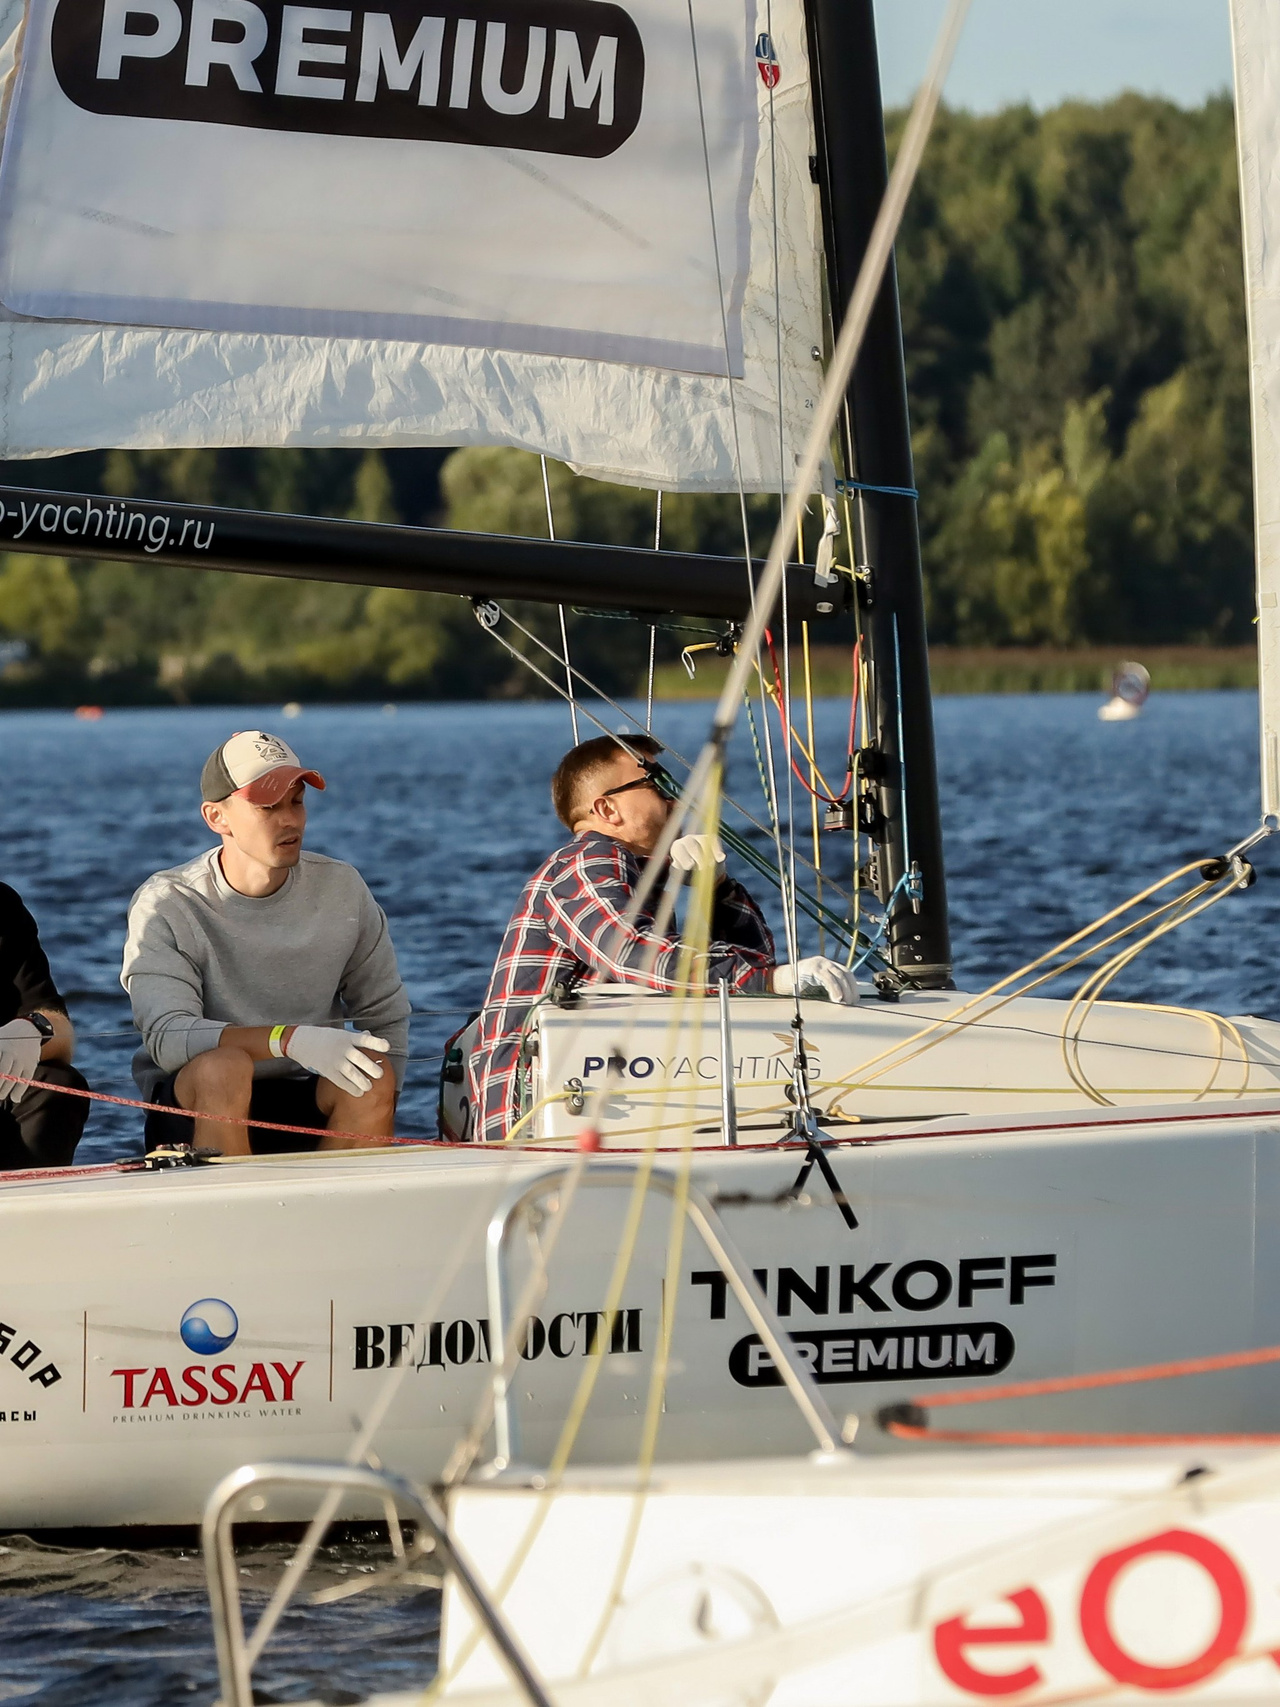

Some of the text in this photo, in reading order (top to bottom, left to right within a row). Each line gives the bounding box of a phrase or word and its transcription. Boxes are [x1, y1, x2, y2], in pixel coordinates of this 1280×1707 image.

[96, 0, 619, 126] PREMIUM
[110, 1360, 308, 1409] TASSAY
[113, 1407, 303, 1424] PREMIUM DRINKING WATER
[934, 1529, 1280, 1696] eO
